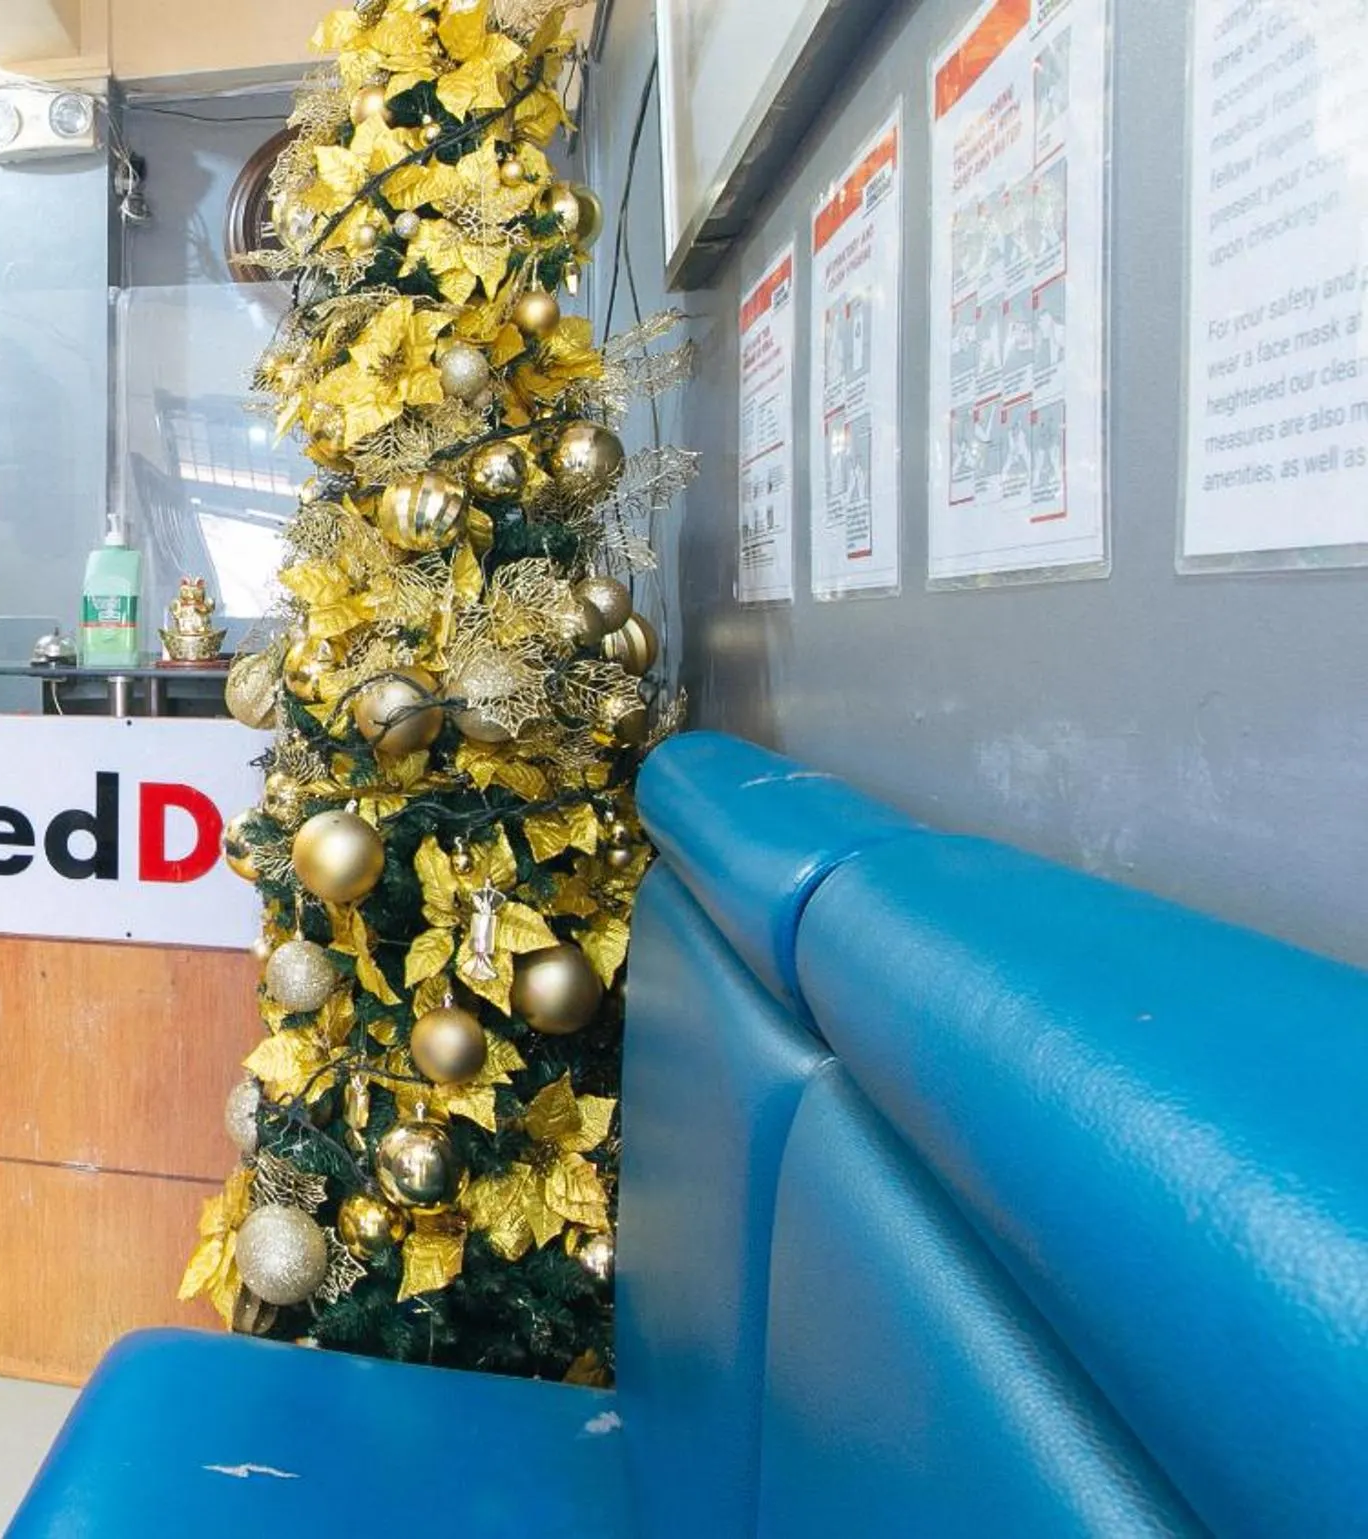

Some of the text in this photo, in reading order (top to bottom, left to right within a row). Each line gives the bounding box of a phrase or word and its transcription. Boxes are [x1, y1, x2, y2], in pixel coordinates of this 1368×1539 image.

[1208, 318, 1231, 342] For
[1234, 305, 1264, 338] your
[1269, 285, 1318, 320] safety
[1323, 264, 1356, 299] and
[1207, 353, 1241, 380] wear
[1243, 348, 1253, 368] a
[1256, 336, 1291, 364] face
[1294, 317, 1341, 352] mask
[1206, 372, 1287, 417] heightened
[1290, 369, 1316, 395] our
[1204, 422, 1275, 454] measures
[1278, 416, 1305, 439] are
[1308, 404, 1346, 433] also
[1280, 457, 1300, 479] as
[1304, 445, 1339, 472] well
[1344, 445, 1367, 468] as
